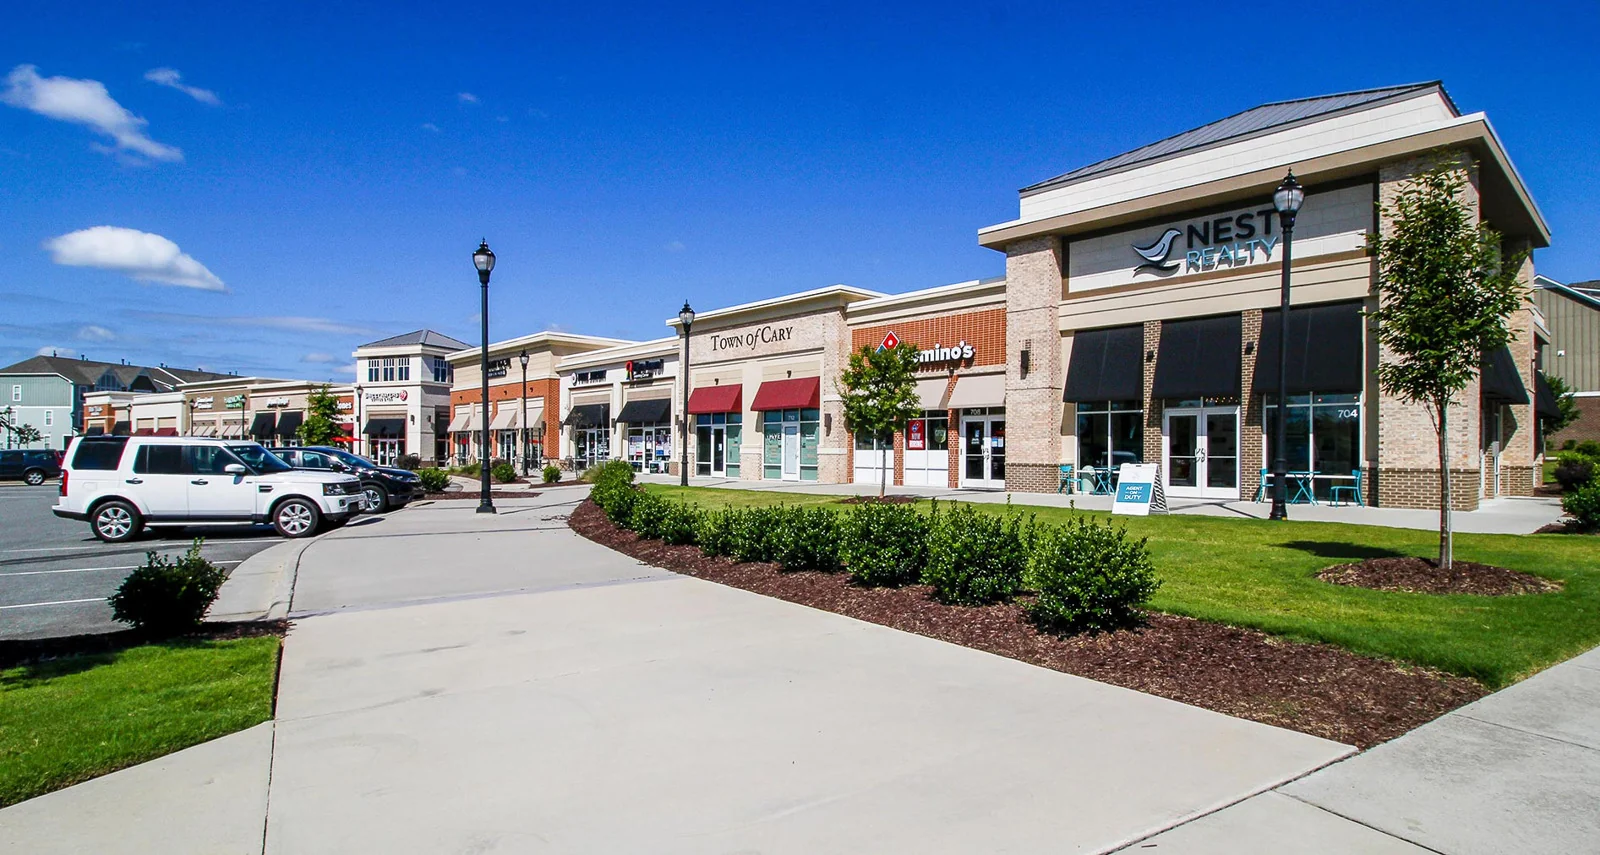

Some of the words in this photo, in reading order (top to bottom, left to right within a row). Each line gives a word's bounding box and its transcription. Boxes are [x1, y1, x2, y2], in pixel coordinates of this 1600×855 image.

[1187, 209, 1277, 248] NEST
[1187, 236, 1278, 268] REALTY
[911, 341, 974, 363] mino's
[1338, 409, 1358, 418] 704
